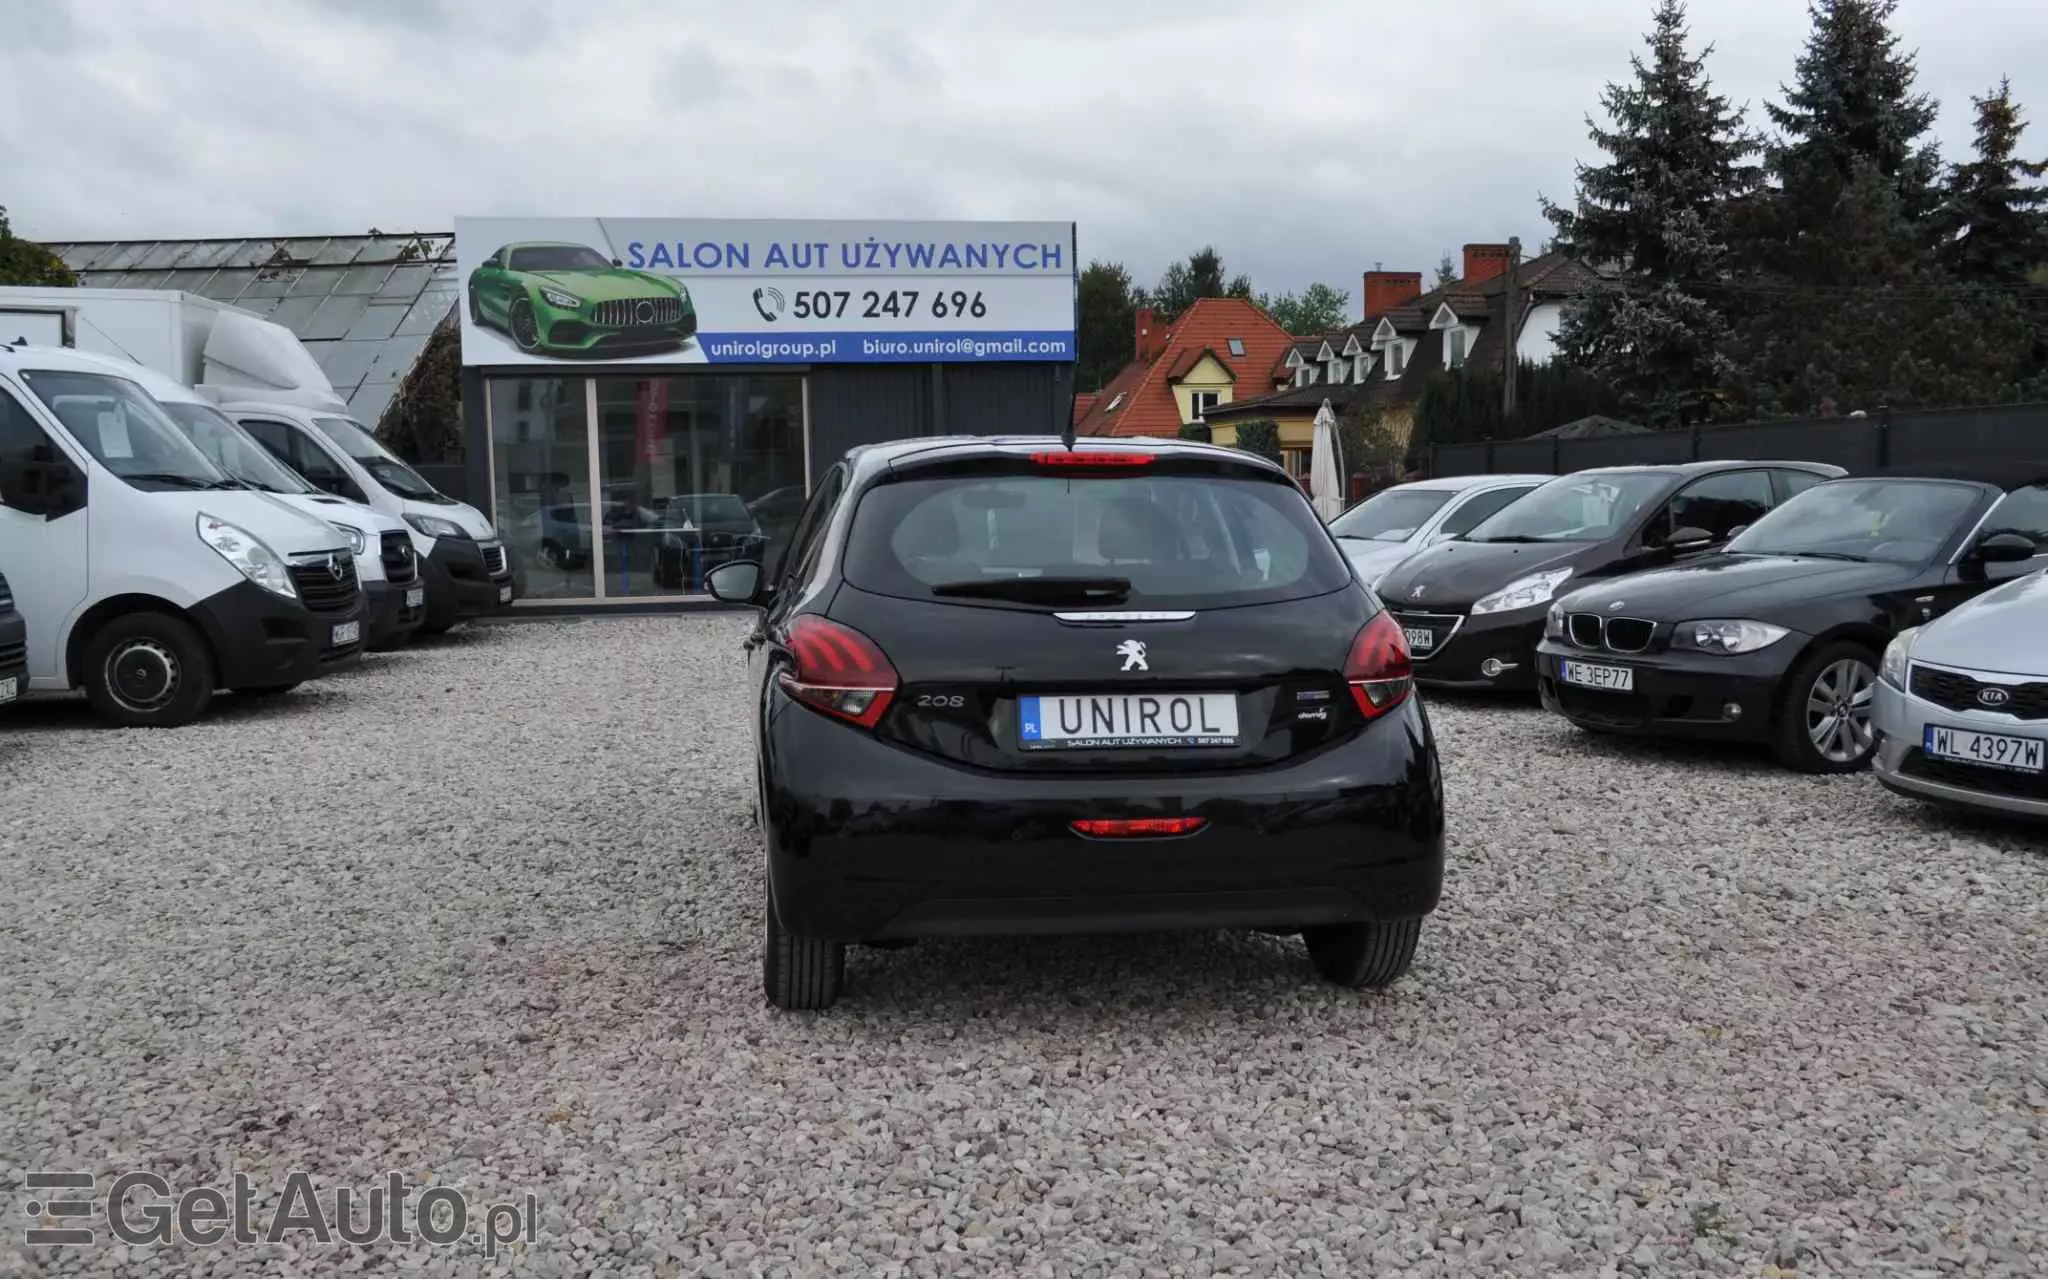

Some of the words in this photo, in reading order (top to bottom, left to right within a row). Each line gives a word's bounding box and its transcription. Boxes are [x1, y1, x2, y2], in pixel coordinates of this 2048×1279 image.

[627, 242, 750, 269] SALON
[764, 242, 829, 269] AUT
[841, 236, 1062, 269] UŻYWANYCH
[792, 291, 851, 319] 507
[862, 290, 919, 318] 247
[931, 290, 987, 318] 696
[711, 339, 836, 357] unirolgroup.pl
[863, 338, 1066, 356] biuro.unirol@gmail.com
[1567, 662, 1583, 682] WE
[1586, 666, 1629, 687] 3EP77
[917, 695, 965, 708] 208
[1023, 722, 1039, 733] PL
[1058, 697, 1221, 734] UNIROL
[1937, 730, 1961, 756] WL
[1969, 735, 2039, 766] 4397W
